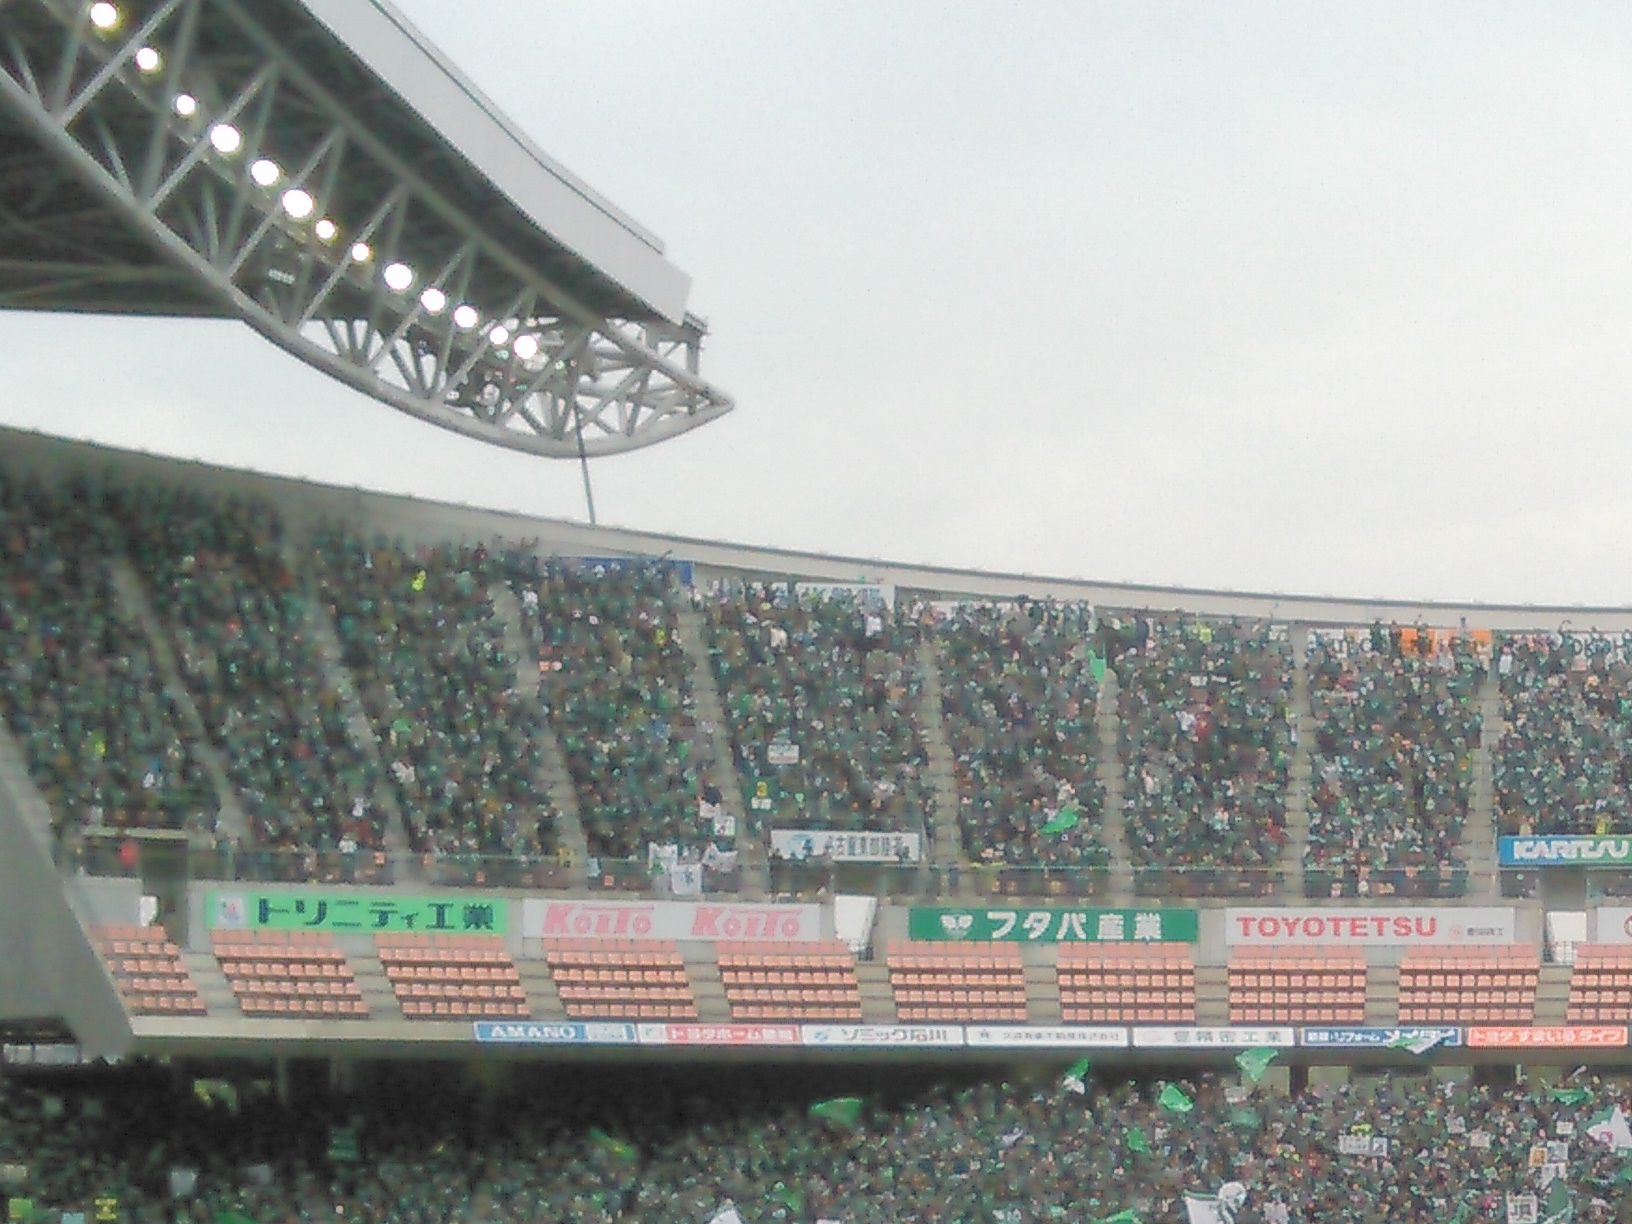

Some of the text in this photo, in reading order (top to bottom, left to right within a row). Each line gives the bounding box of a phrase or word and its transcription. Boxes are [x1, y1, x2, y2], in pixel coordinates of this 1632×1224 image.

[257, 898, 494, 931] トリニティ工業
[987, 911, 1162, 940] フタバ産業
[1236, 915, 1438, 937] TOYOTETSU
[491, 1025, 576, 1039] AMANO
